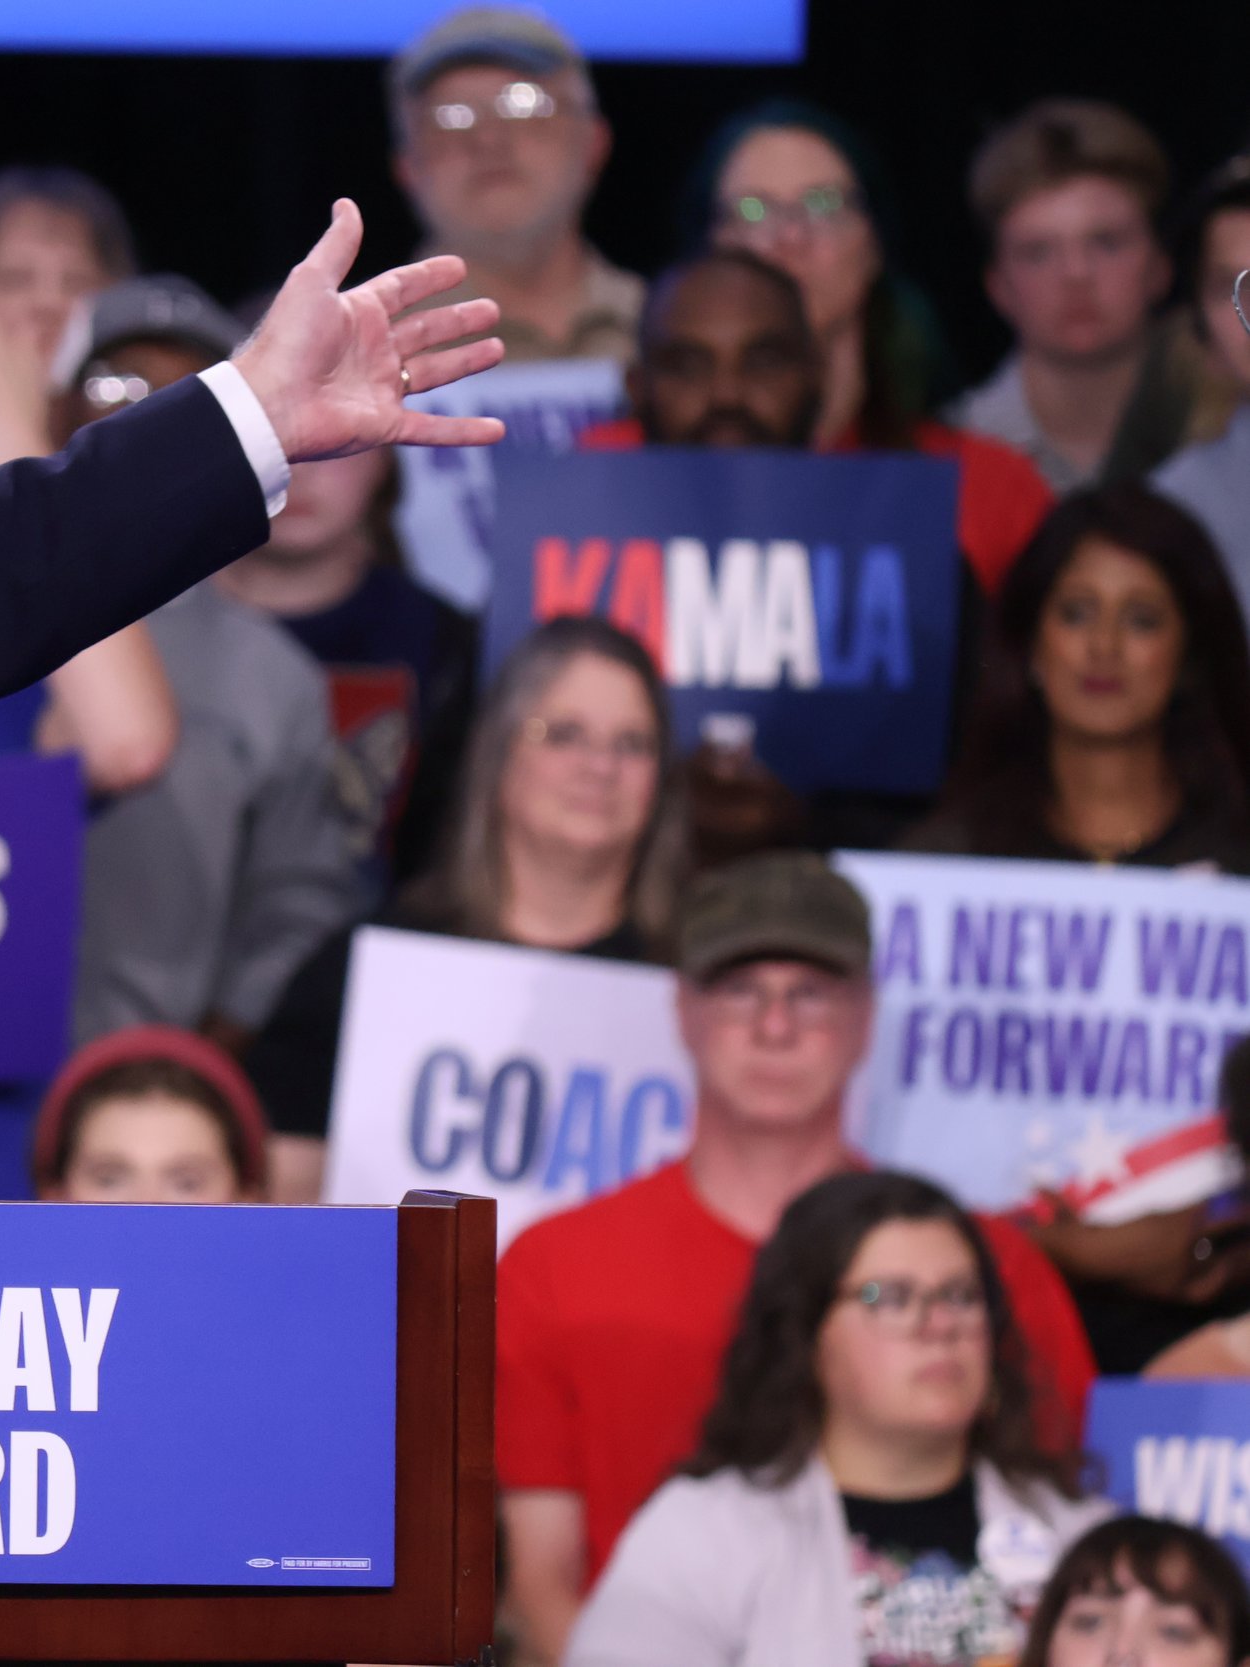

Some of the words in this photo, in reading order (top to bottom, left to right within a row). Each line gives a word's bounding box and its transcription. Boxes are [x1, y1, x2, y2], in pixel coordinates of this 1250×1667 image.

[533, 537, 912, 690] KAMALA
[880, 902, 922, 986] A
[951, 905, 1112, 993] NEW
